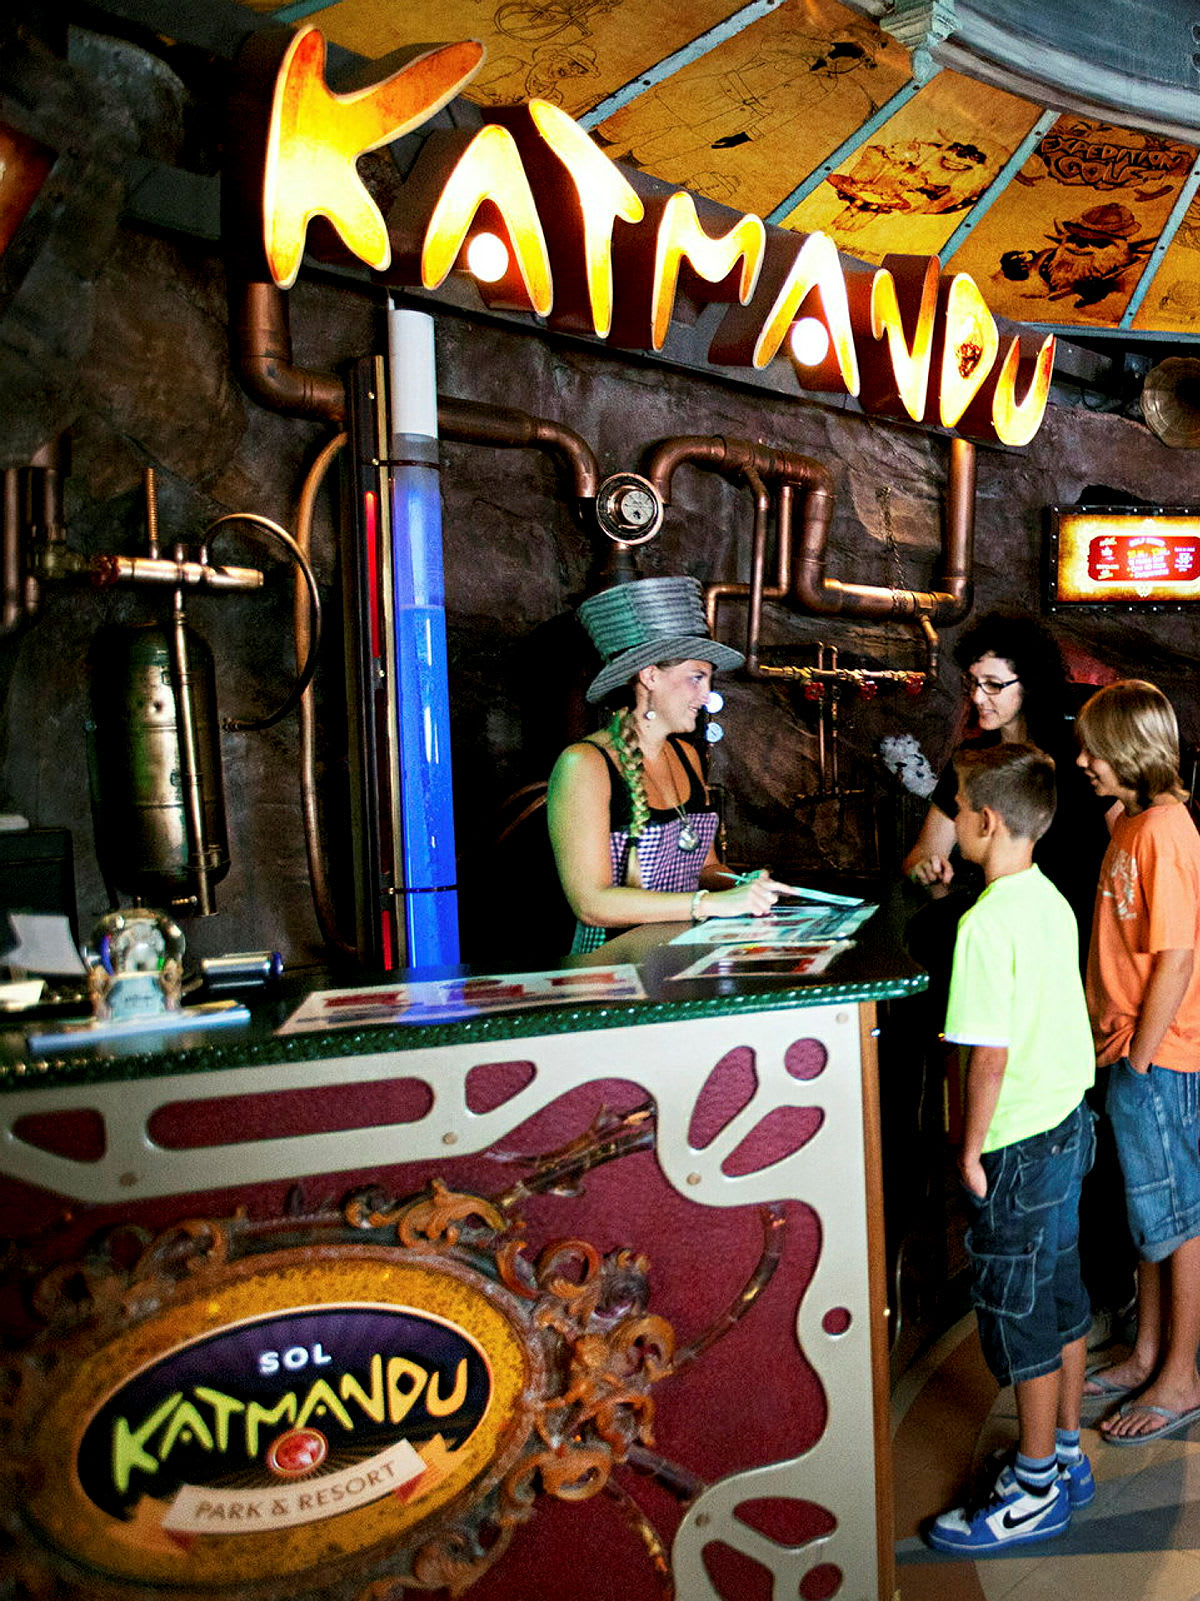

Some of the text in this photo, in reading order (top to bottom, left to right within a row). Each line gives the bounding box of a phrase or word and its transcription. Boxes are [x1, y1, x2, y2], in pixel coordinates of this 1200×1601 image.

[264, 24, 1057, 447] KATMANDU
[259, 1344, 332, 1374] SOL
[114, 1353, 468, 1492] KATMANDU
[196, 1461, 398, 1521] PARK & RESORT
